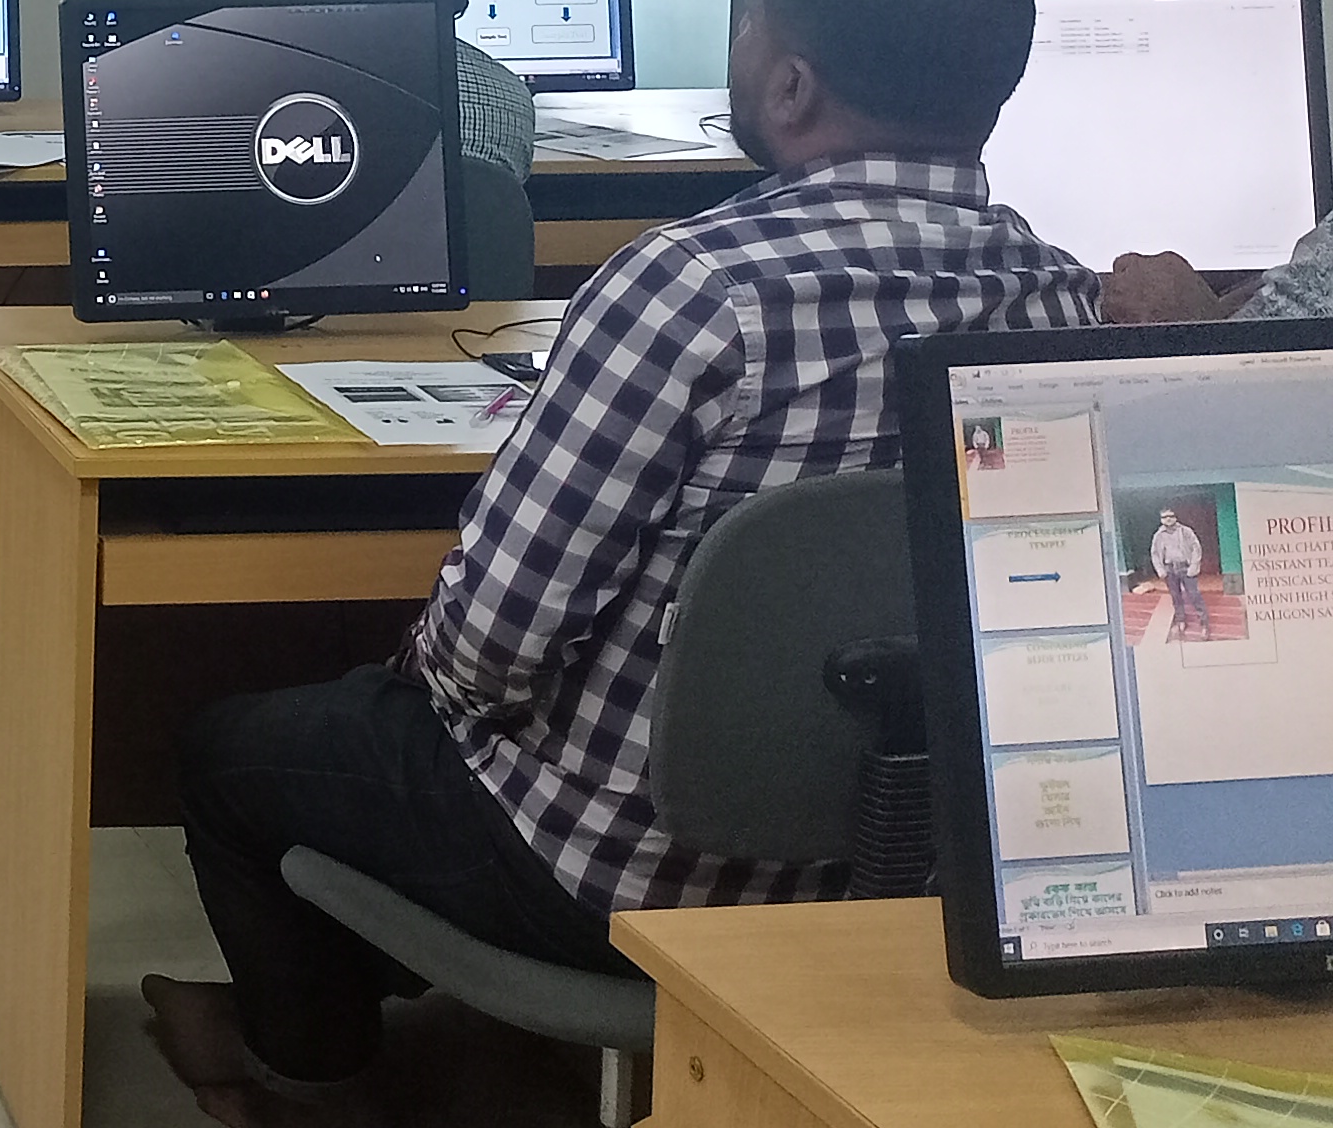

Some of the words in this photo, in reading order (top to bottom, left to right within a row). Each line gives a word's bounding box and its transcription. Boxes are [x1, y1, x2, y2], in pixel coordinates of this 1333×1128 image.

[260, 135, 352, 166] DELL
[1250, 557, 1313, 572] ASSISTANT
[1256, 574, 1316, 589] PHYSICAL
[1295, 590, 1329, 603] HIGH
